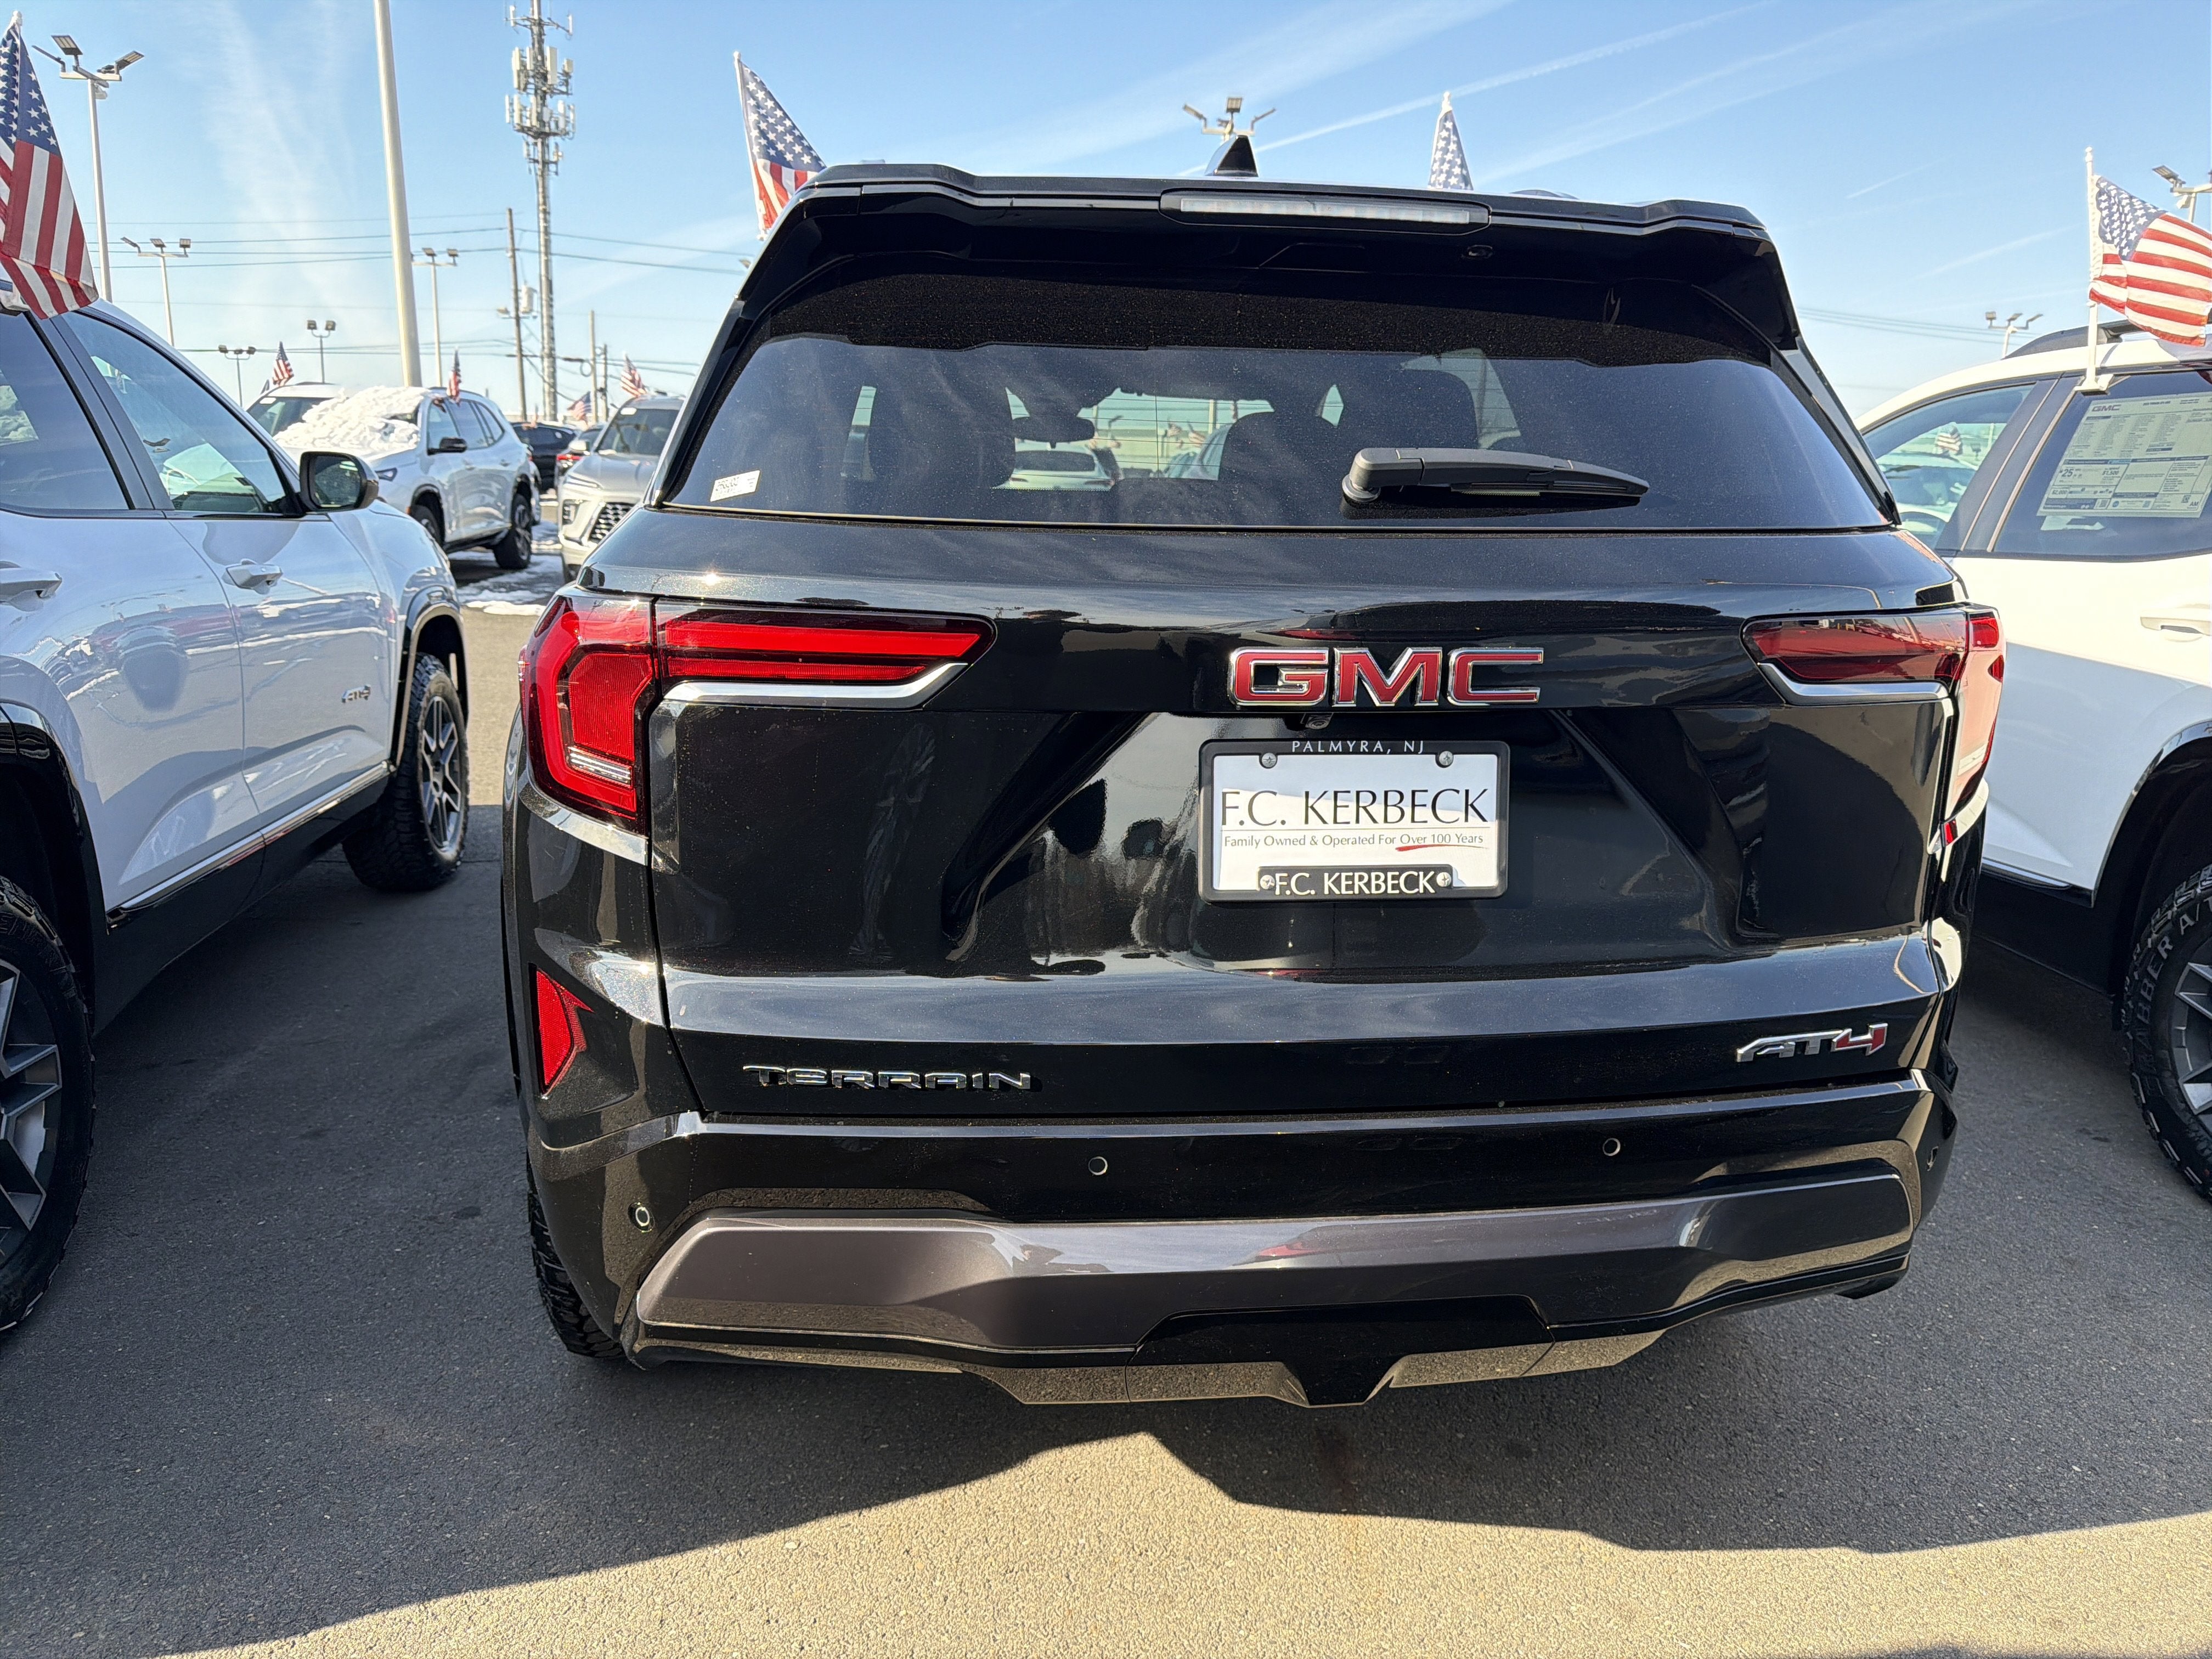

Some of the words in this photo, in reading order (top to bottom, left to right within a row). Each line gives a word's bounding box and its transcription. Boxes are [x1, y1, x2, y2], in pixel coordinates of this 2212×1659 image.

[2062, 469, 2074, 477] 25
[1228, 646, 1544, 707] GMC
[1291, 740, 1391, 754] PALMYRA,
[1403, 740, 1424, 754] NJ
[1221, 790, 1286, 826] F.C.
[1304, 788, 1489, 825] KERBECK
[1224, 835, 1261, 849] Family
[1263, 835, 1306, 846] Owned
[1310, 835, 1318, 846] &
[1322, 834, 1375, 848] Operated
[1379, 834, 1396, 845] For
[1400, 833, 1427, 845] Over
[1431, 833, 1451, 844] 100
[1455, 833, 1483, 844] Years
[1274, 872, 1316, 895] F.C.
[1324, 871, 1436, 895] KERBECK
[1735, 1022, 1888, 1063] AT4
[742, 1065, 1032, 1090] TERRAIN
